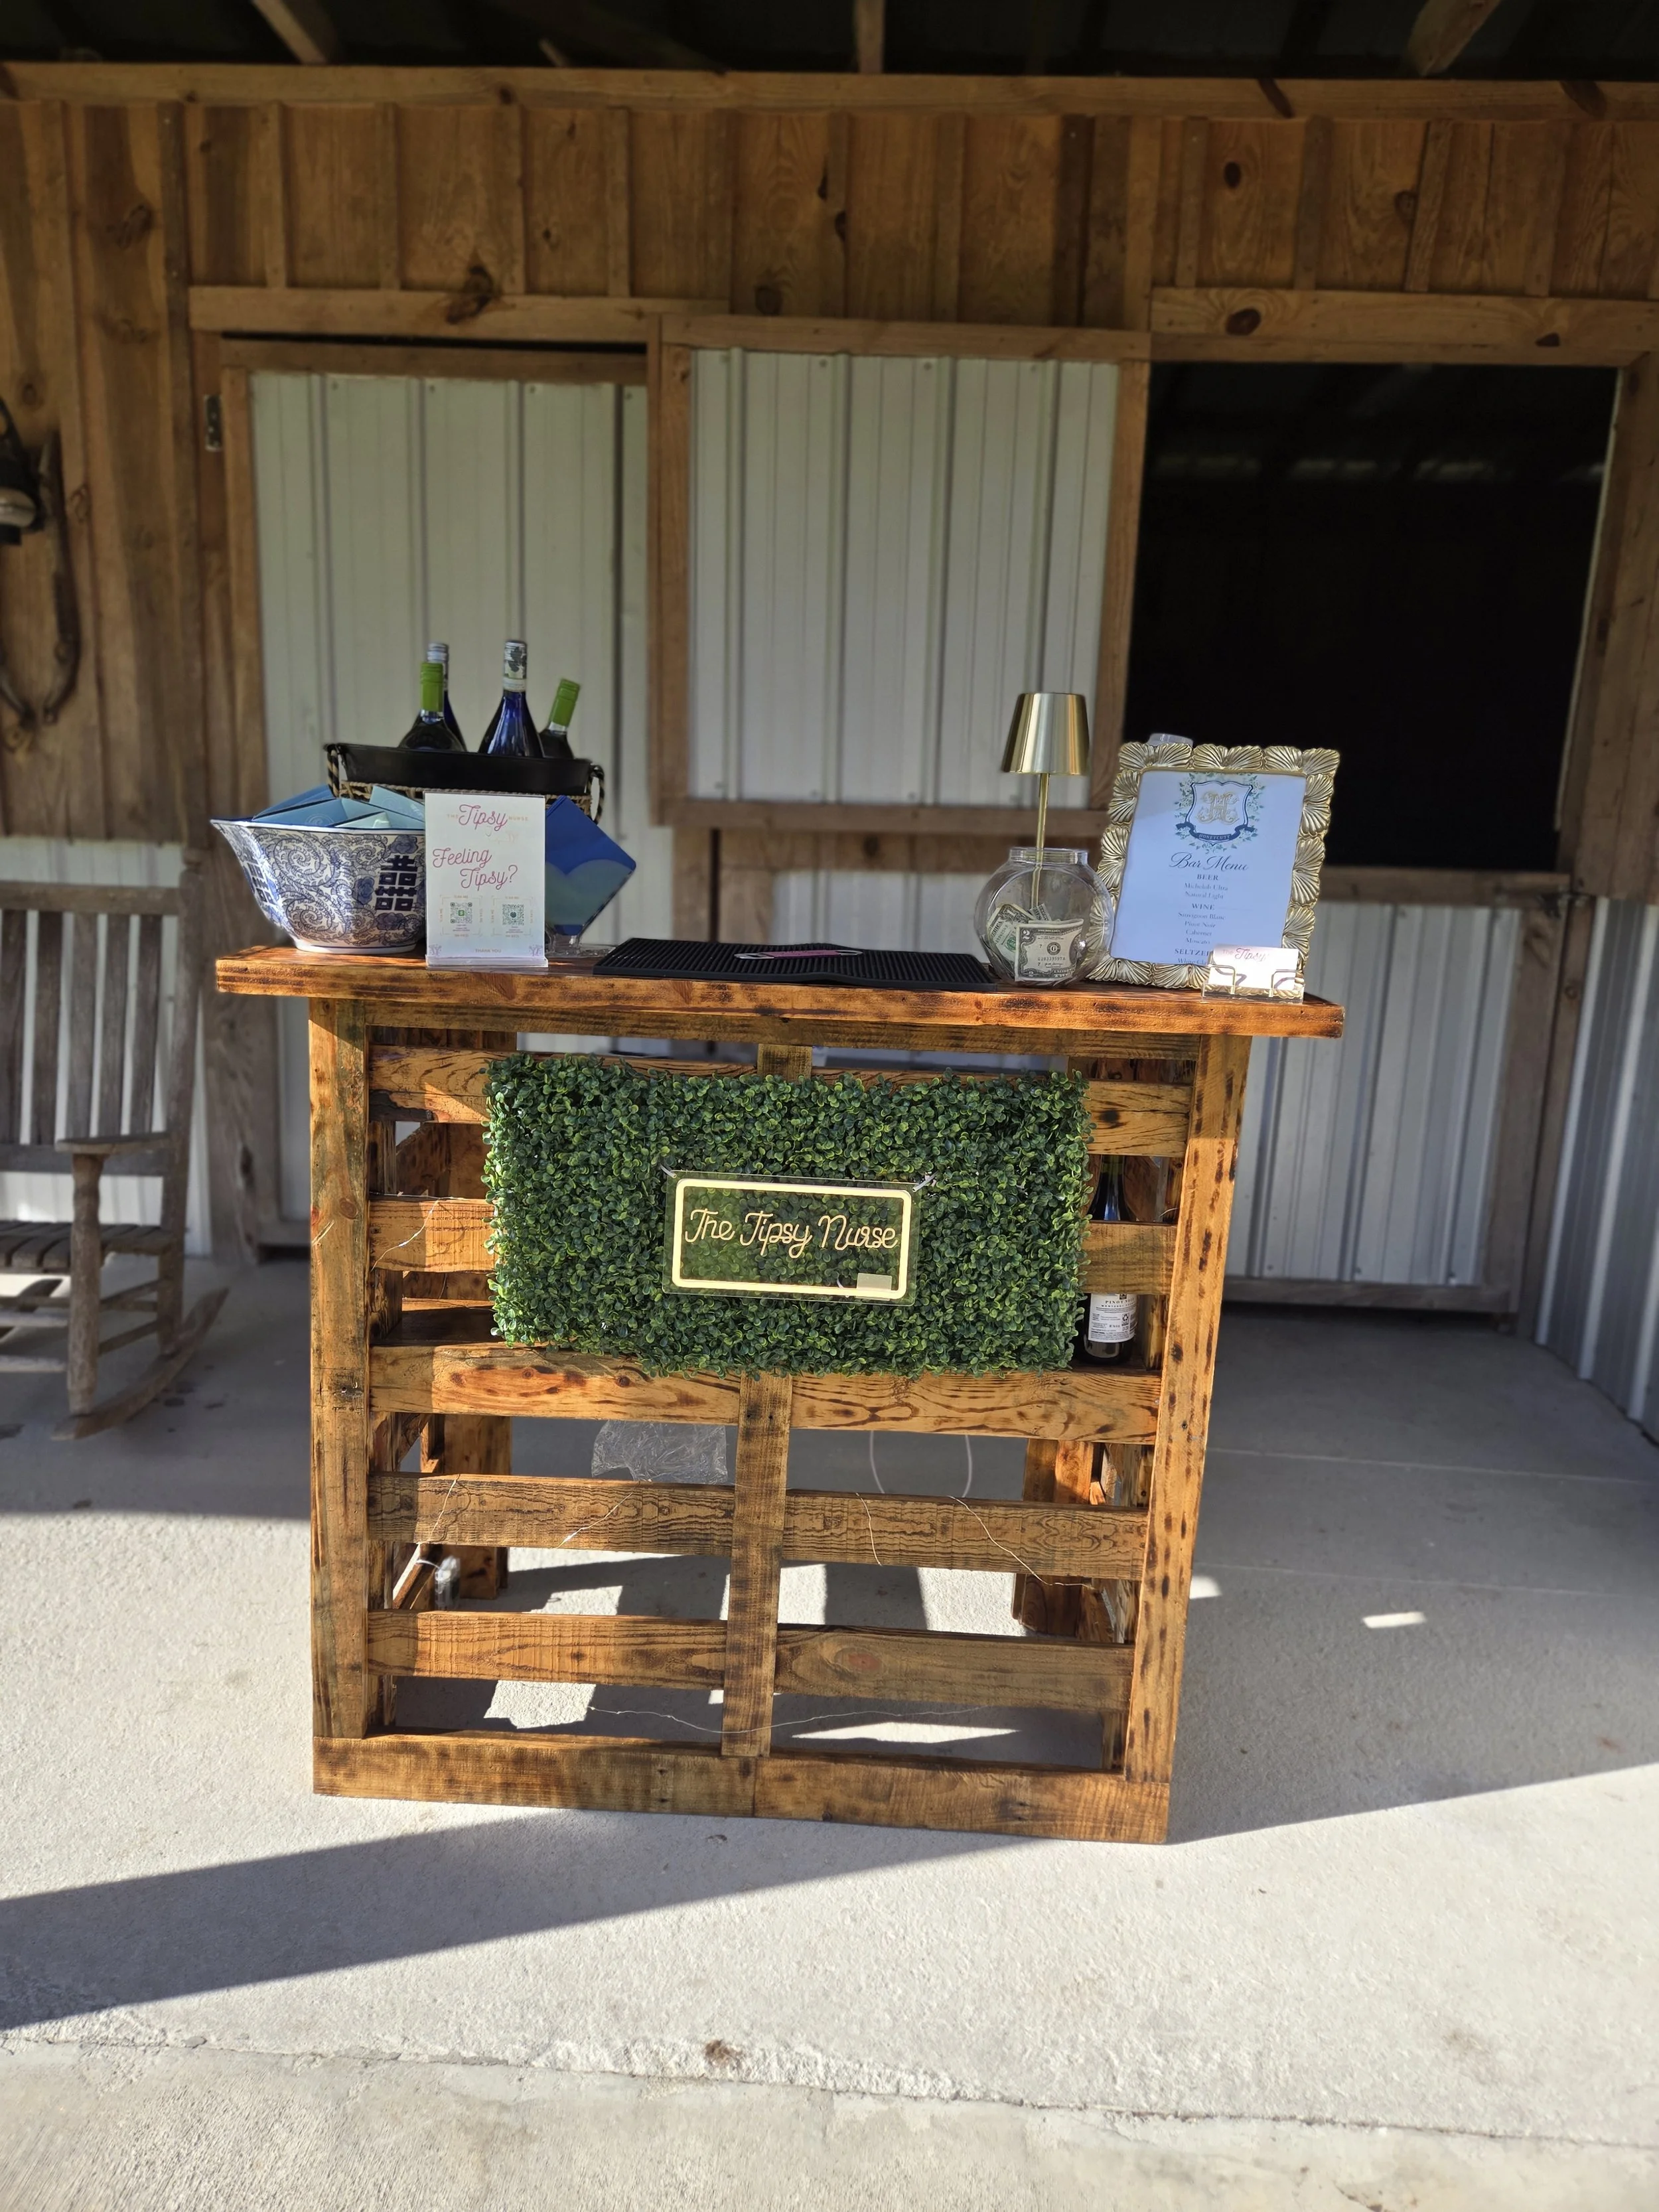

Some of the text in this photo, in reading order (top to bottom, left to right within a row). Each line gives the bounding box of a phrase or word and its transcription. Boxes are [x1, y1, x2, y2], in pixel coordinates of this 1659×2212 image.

[459, 804, 508, 832] Tipsy
[433, 848, 492, 869] Feeling
[1169, 851, 1249, 871] Bar Menu
[460, 864, 518, 891] Tipsy?
[1234, 948, 1266, 962] Tipsy
[684, 1208, 899, 1259] The Tipsy Nurse
